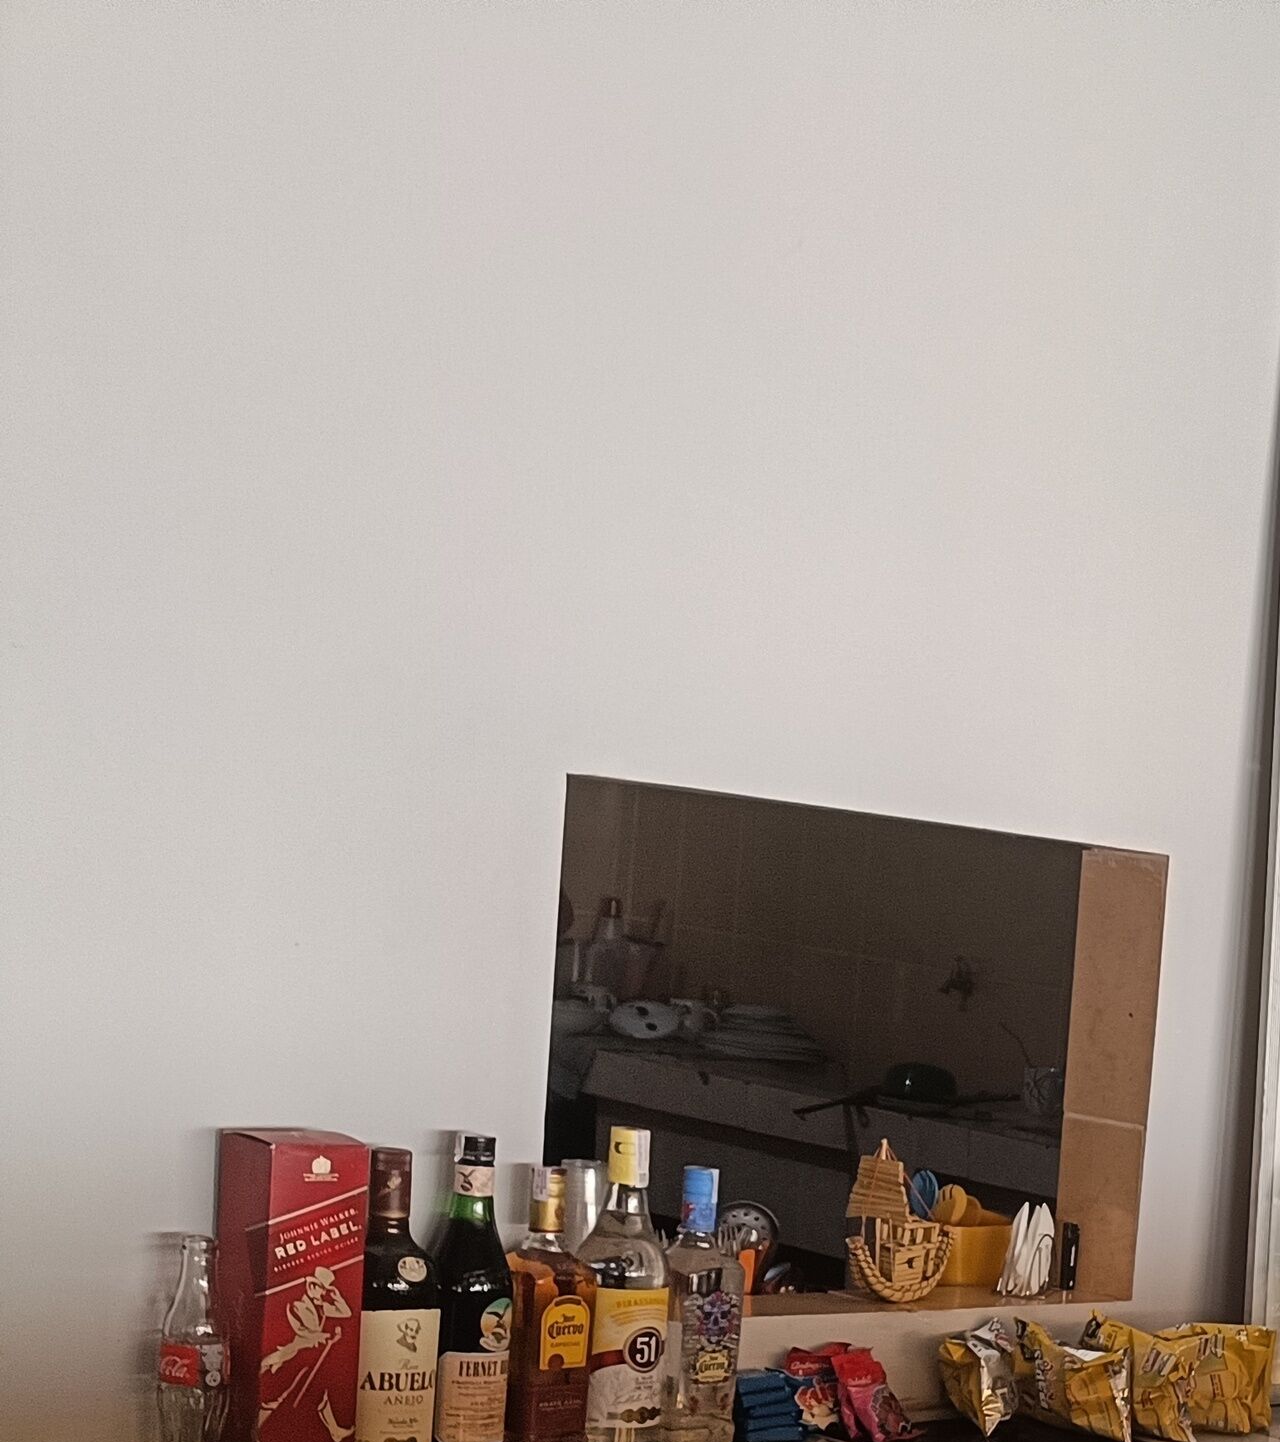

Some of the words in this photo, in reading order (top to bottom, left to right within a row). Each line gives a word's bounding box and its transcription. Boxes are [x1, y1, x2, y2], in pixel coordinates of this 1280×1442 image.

[279, 1222, 319, 1244] JOHNNIE
[274, 1239, 308, 1260] RED
[635, 1336, 657, 1364] 51
[458, 1360, 499, 1378] FERNET
